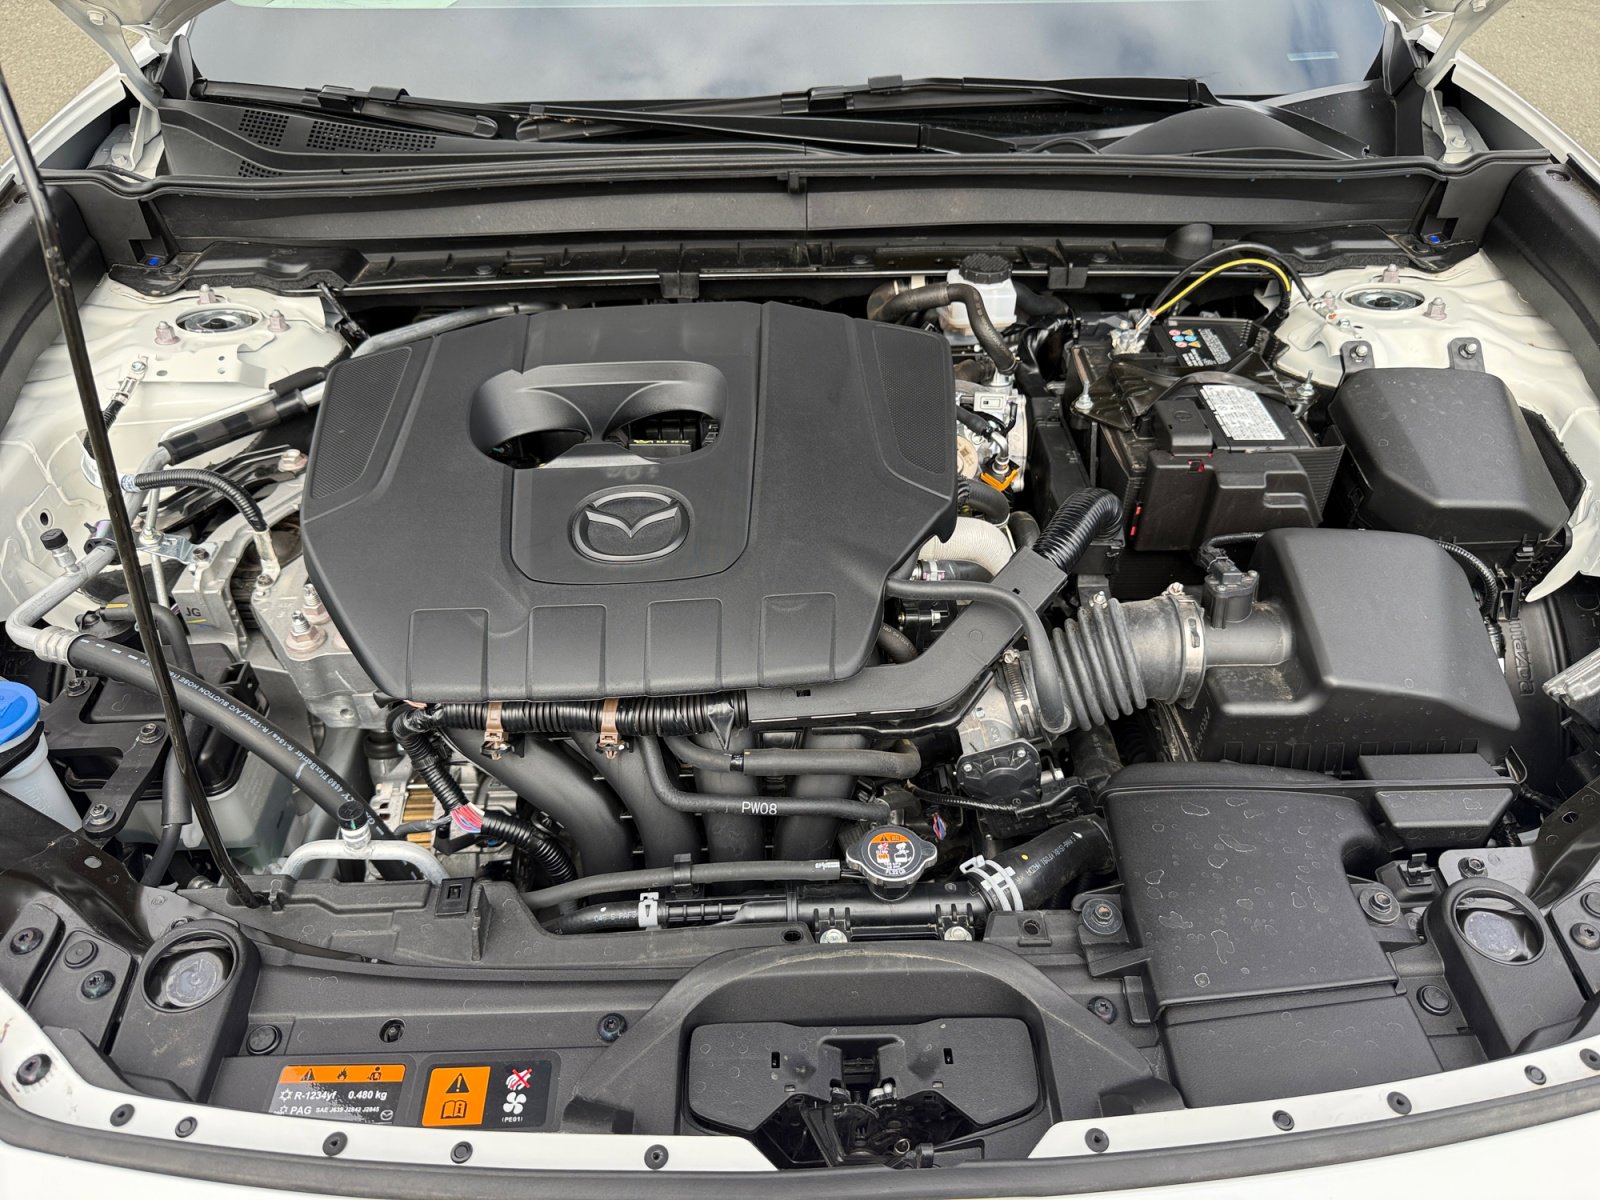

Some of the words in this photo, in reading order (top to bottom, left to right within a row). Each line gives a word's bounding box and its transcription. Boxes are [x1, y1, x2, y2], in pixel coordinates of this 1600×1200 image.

[185, 607, 202, 617] JG
[179, 676, 199, 690] HOSE
[199, 687, 230, 707] SUCTION
[294, 749, 330, 781] FlexBarrier
[741, 801, 778, 815] PW08
[294, 1090, 338, 1101] R-1234yf
[347, 1090, 374, 1100] 0.480
[374, 1090, 388, 1101] kg
[289, 1105, 313, 1115] PAG
